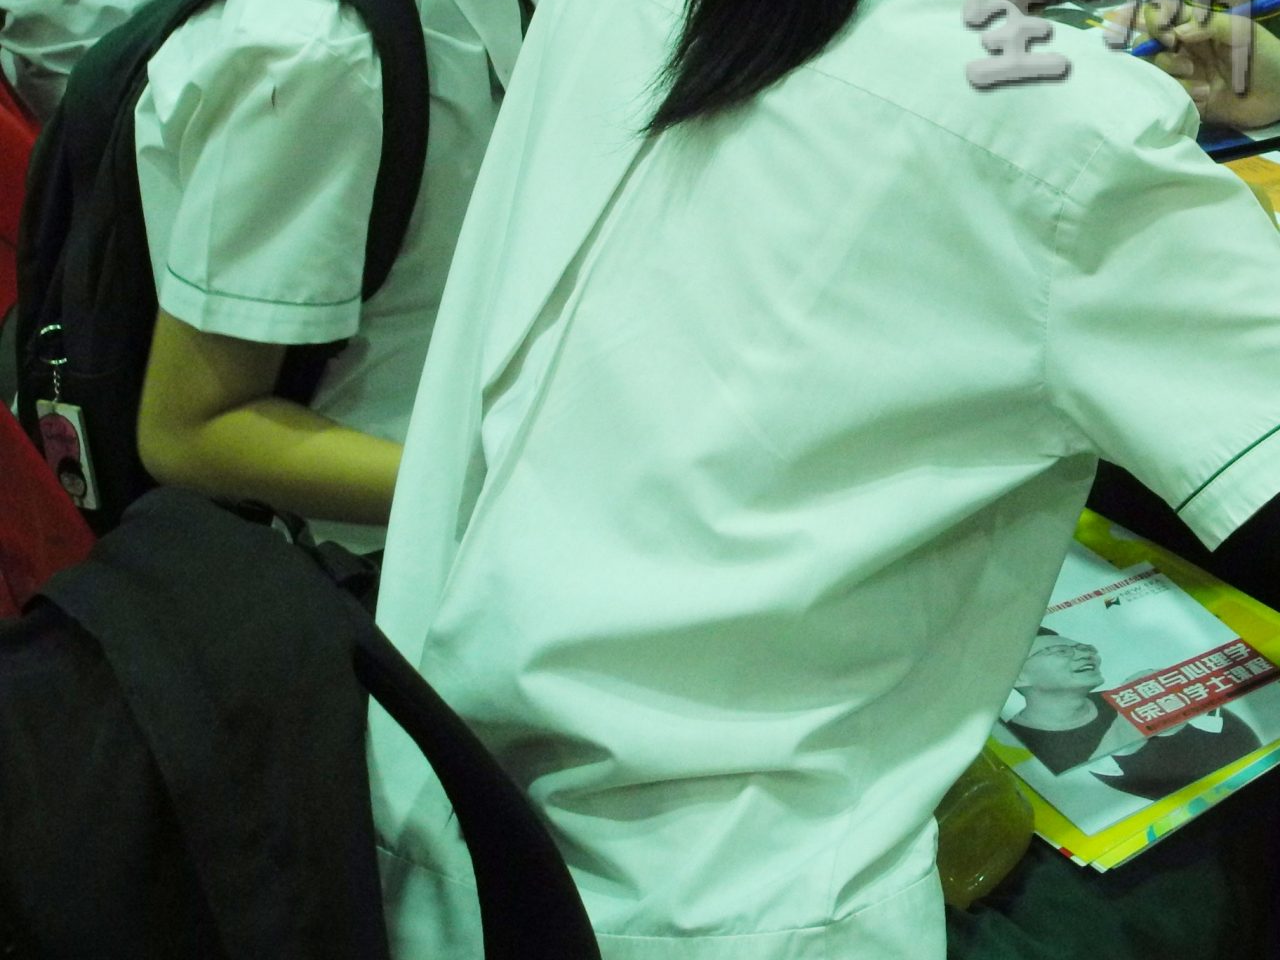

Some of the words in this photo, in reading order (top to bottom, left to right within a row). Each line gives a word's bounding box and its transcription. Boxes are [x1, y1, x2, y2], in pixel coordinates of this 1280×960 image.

[1112, 643, 1251, 708] 咨商与心理学
